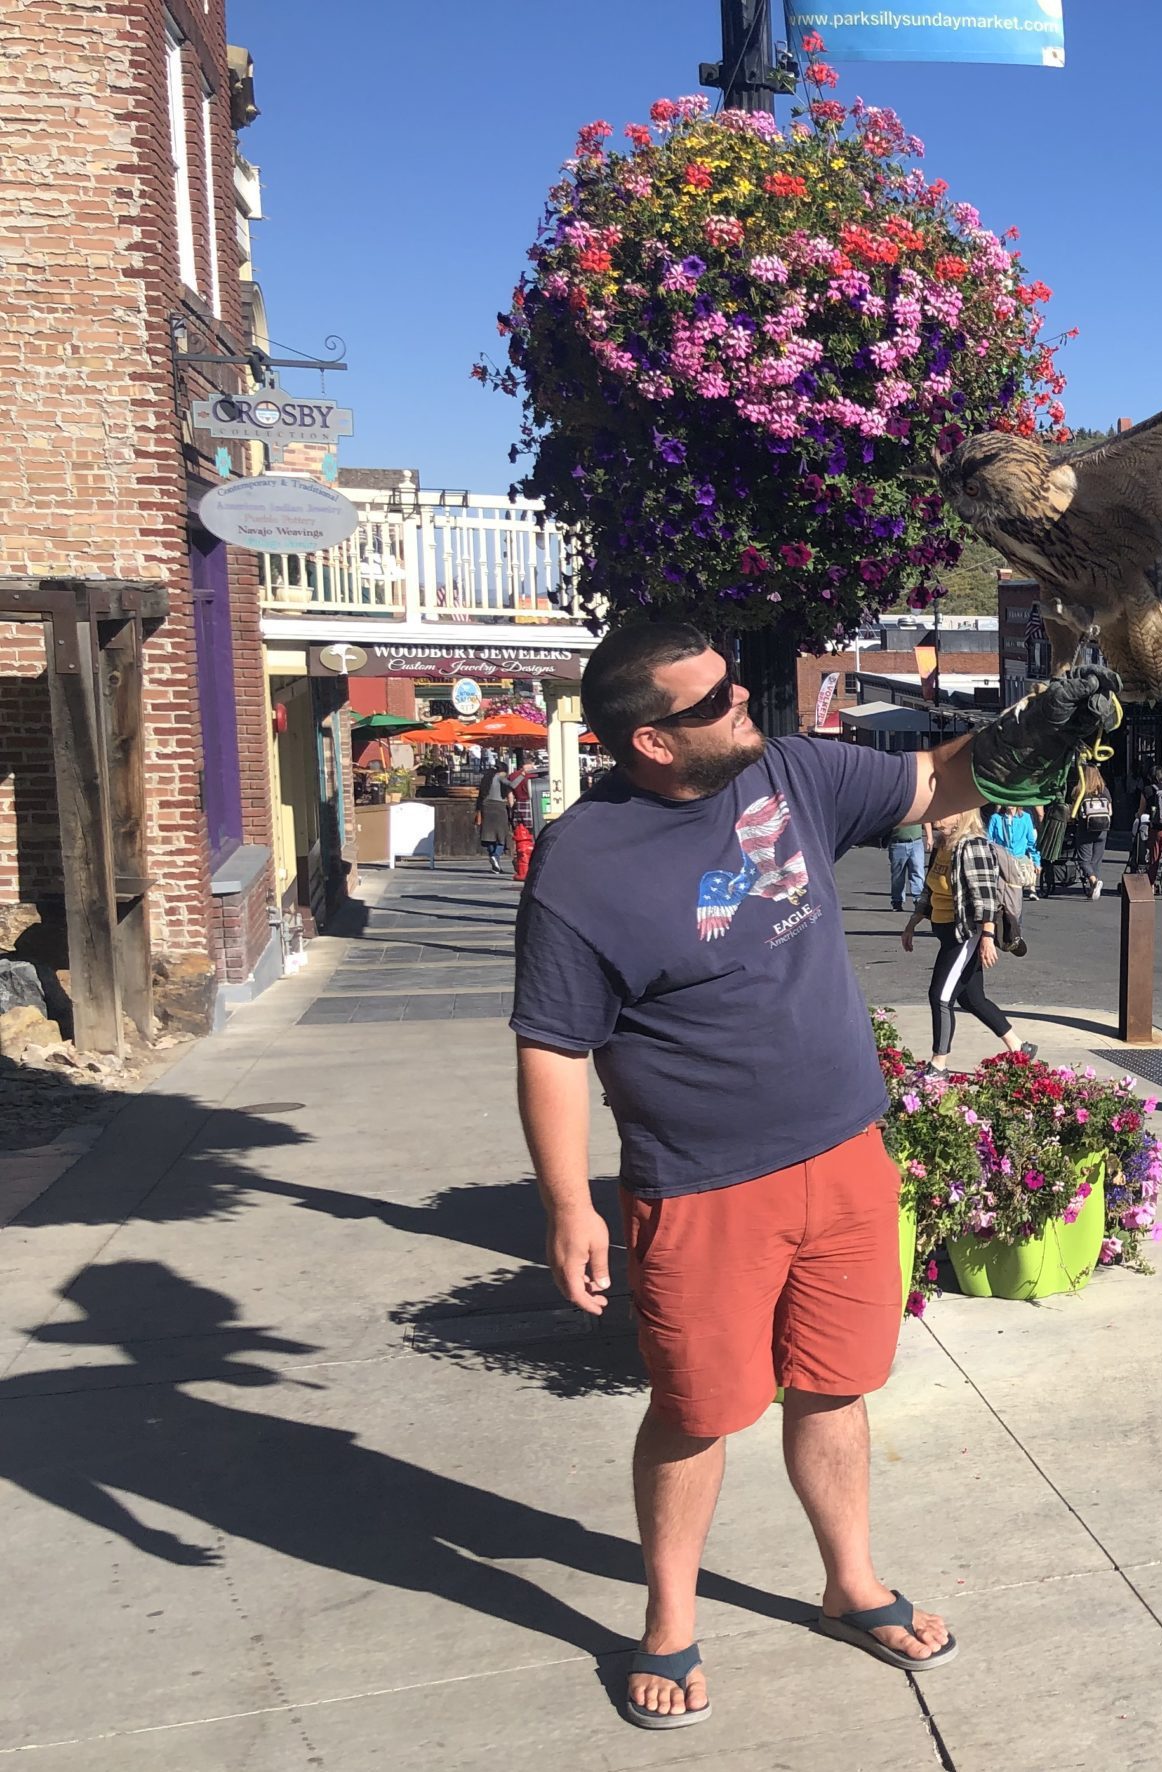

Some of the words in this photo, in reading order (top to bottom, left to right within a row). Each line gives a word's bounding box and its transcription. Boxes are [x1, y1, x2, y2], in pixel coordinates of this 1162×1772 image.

[788, 10, 1062, 33] www.parksillysundaymarket.com
[212, 400, 334, 429] CROSBY
[219, 428, 329, 440] COLLECTION
[217, 479, 277, 497] Contemporary
[292, 480, 340, 502] Traditional
[238, 525, 273, 537] Navajo
[276, 527, 324, 538] Weavings
[373, 645, 477, 659] WOODBURY
[480, 646, 572, 661] JEWELERS
[387, 658, 436, 672] Custom
[439, 660, 497, 675] Jewelry
[500, 660, 556, 675] Designs
[773, 904, 813, 934] EAGLE
